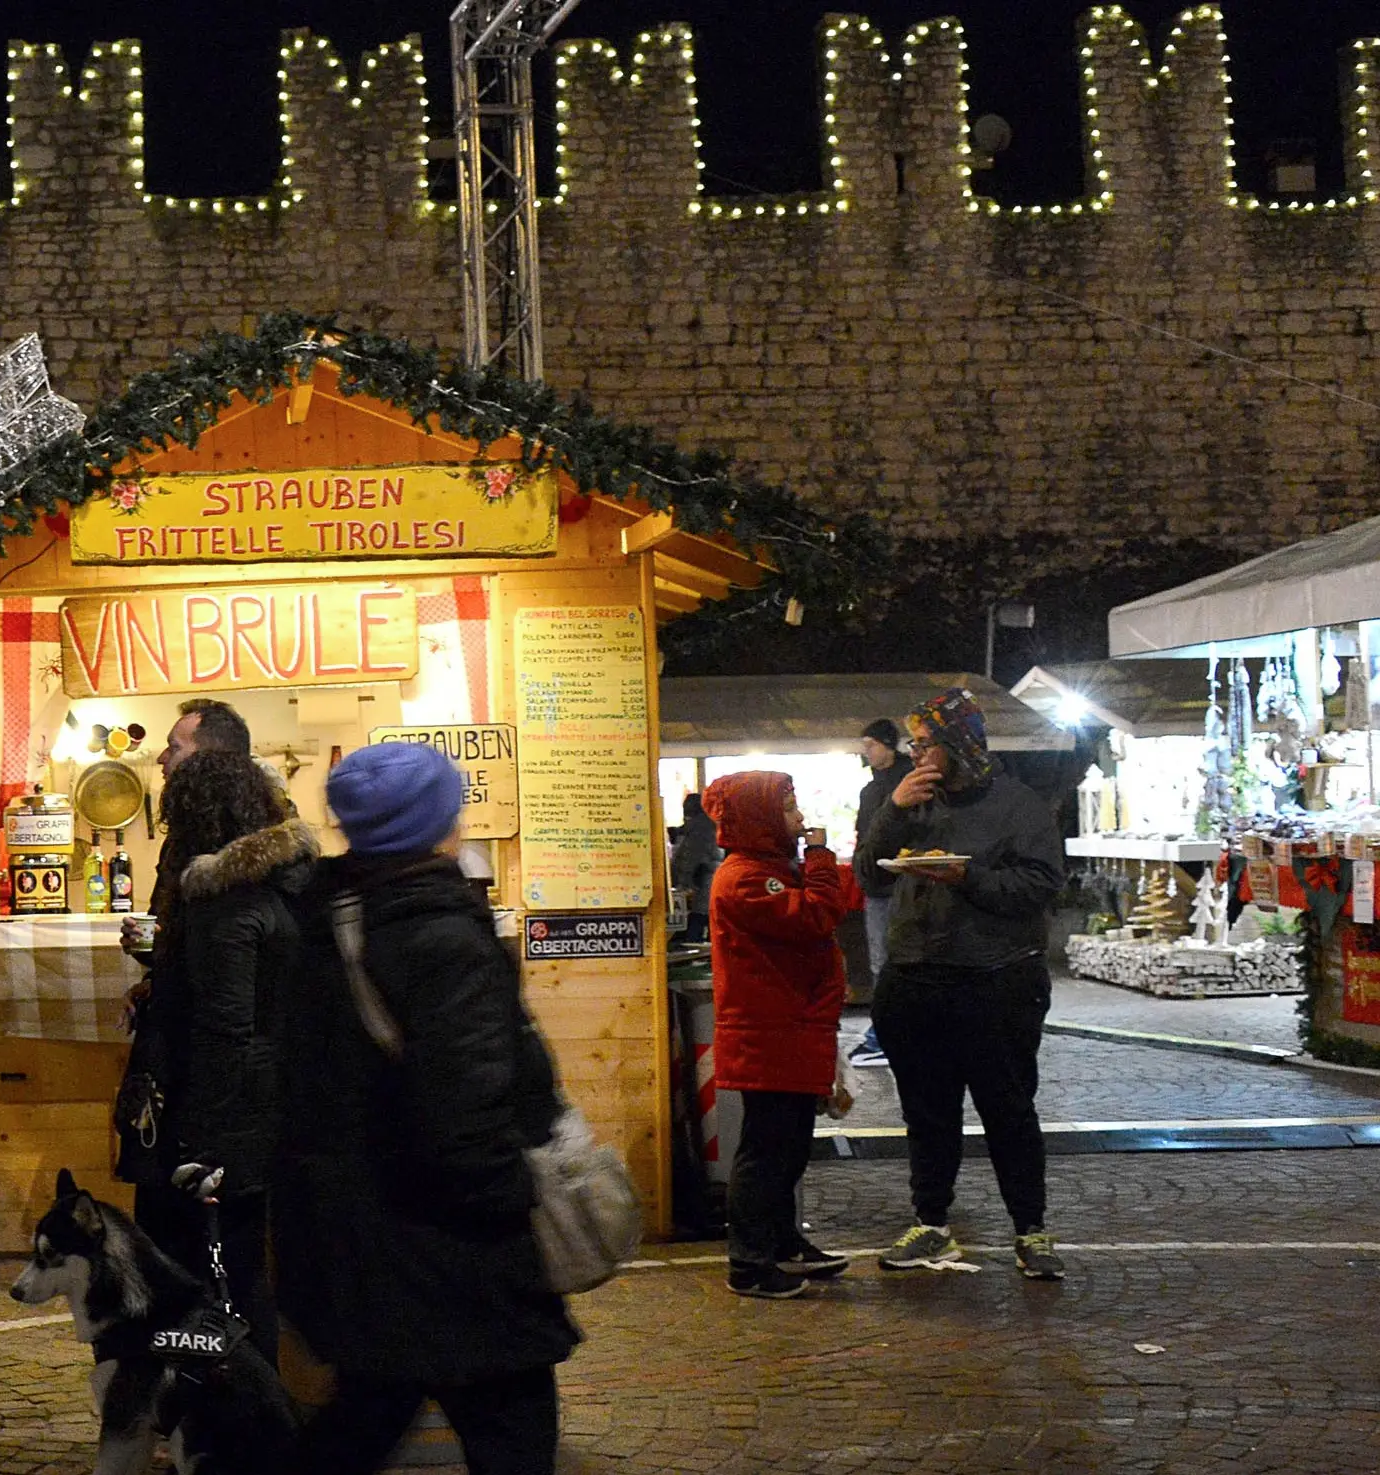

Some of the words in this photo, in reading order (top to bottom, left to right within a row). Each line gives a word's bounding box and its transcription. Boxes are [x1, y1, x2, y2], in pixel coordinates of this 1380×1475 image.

[201, 477, 405, 517] STRAUBEN
[114, 525, 284, 558] FRITTELLE
[308, 520, 466, 552] TIROLESI
[61, 599, 171, 695] VIN
[575, 921, 638, 937] GRAPPA
[152, 1330, 223, 1353] STARK
